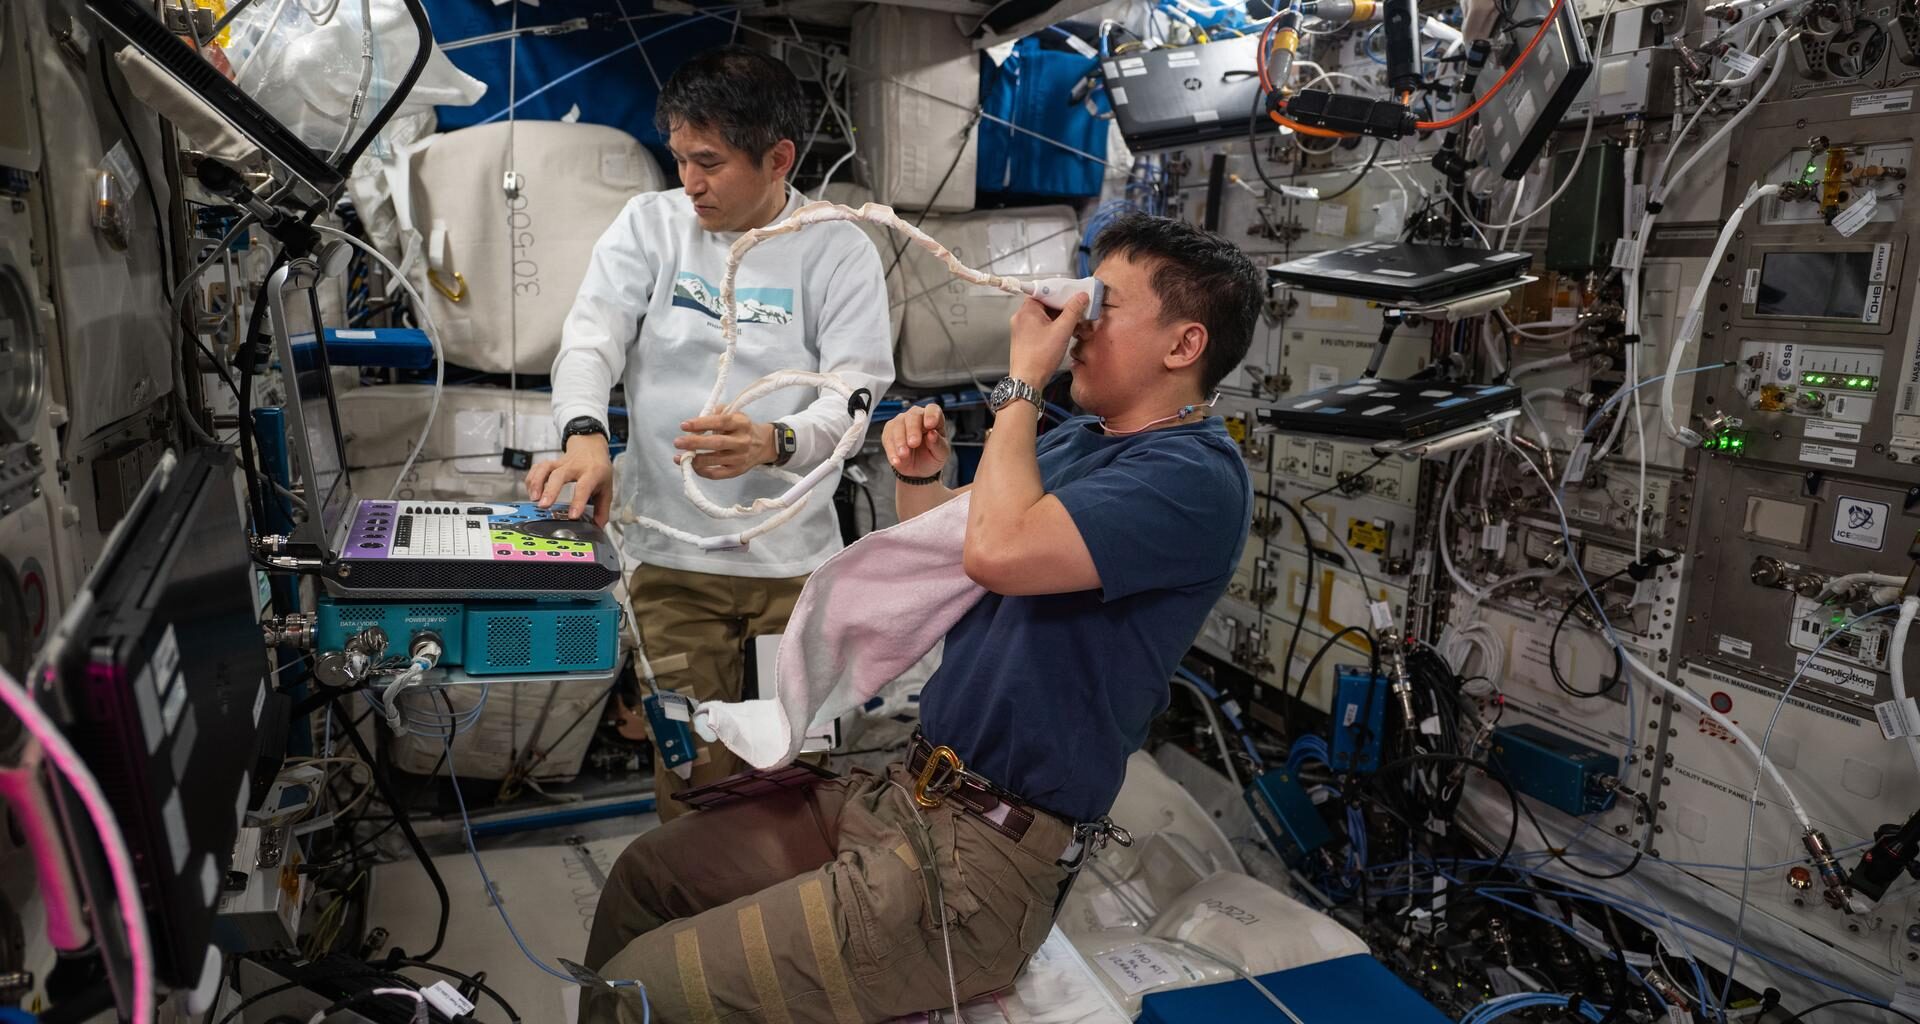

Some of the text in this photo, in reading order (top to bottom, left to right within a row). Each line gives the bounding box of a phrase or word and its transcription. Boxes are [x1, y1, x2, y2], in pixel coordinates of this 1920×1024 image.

[1869, 286, 1882, 313] OHB
[1783, 344, 1793, 366] esa
[1712, 673, 1730, 684] DATA
[1730, 678, 1778, 700] MANAGEMENT
[1778, 692, 1805, 708] SSTEM
[1805, 704, 1836, 718] ACCESS
[1836, 713, 1862, 727] PANEL
[1674, 767, 1767, 809] FACILITY SERVICE PANEL (SP)
